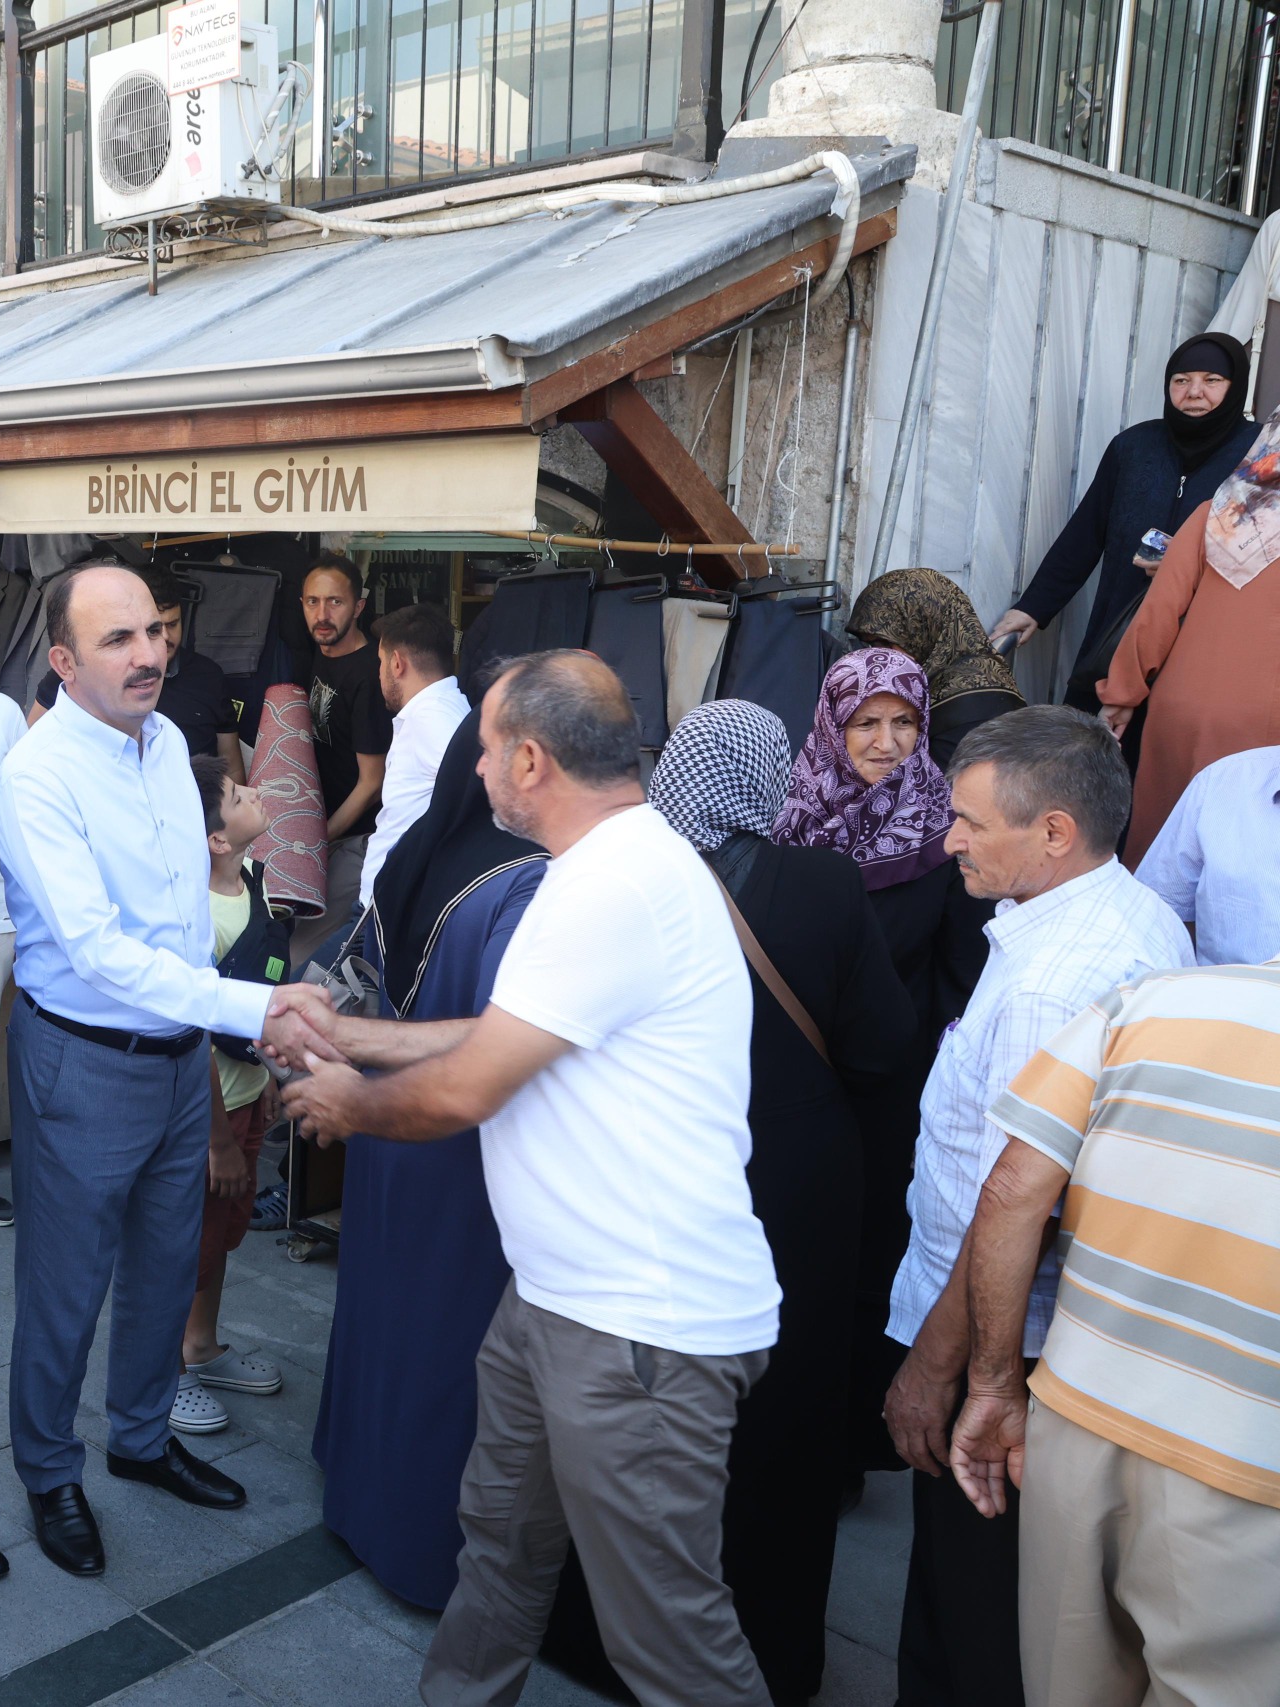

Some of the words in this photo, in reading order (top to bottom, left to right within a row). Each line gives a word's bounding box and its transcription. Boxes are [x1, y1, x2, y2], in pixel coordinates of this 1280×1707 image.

[184, 11, 236, 38] NAVTECS
[88, 461, 198, 514] BİRİNCİ
[210, 470, 242, 513] EL
[254, 456, 368, 514] GİYİM
